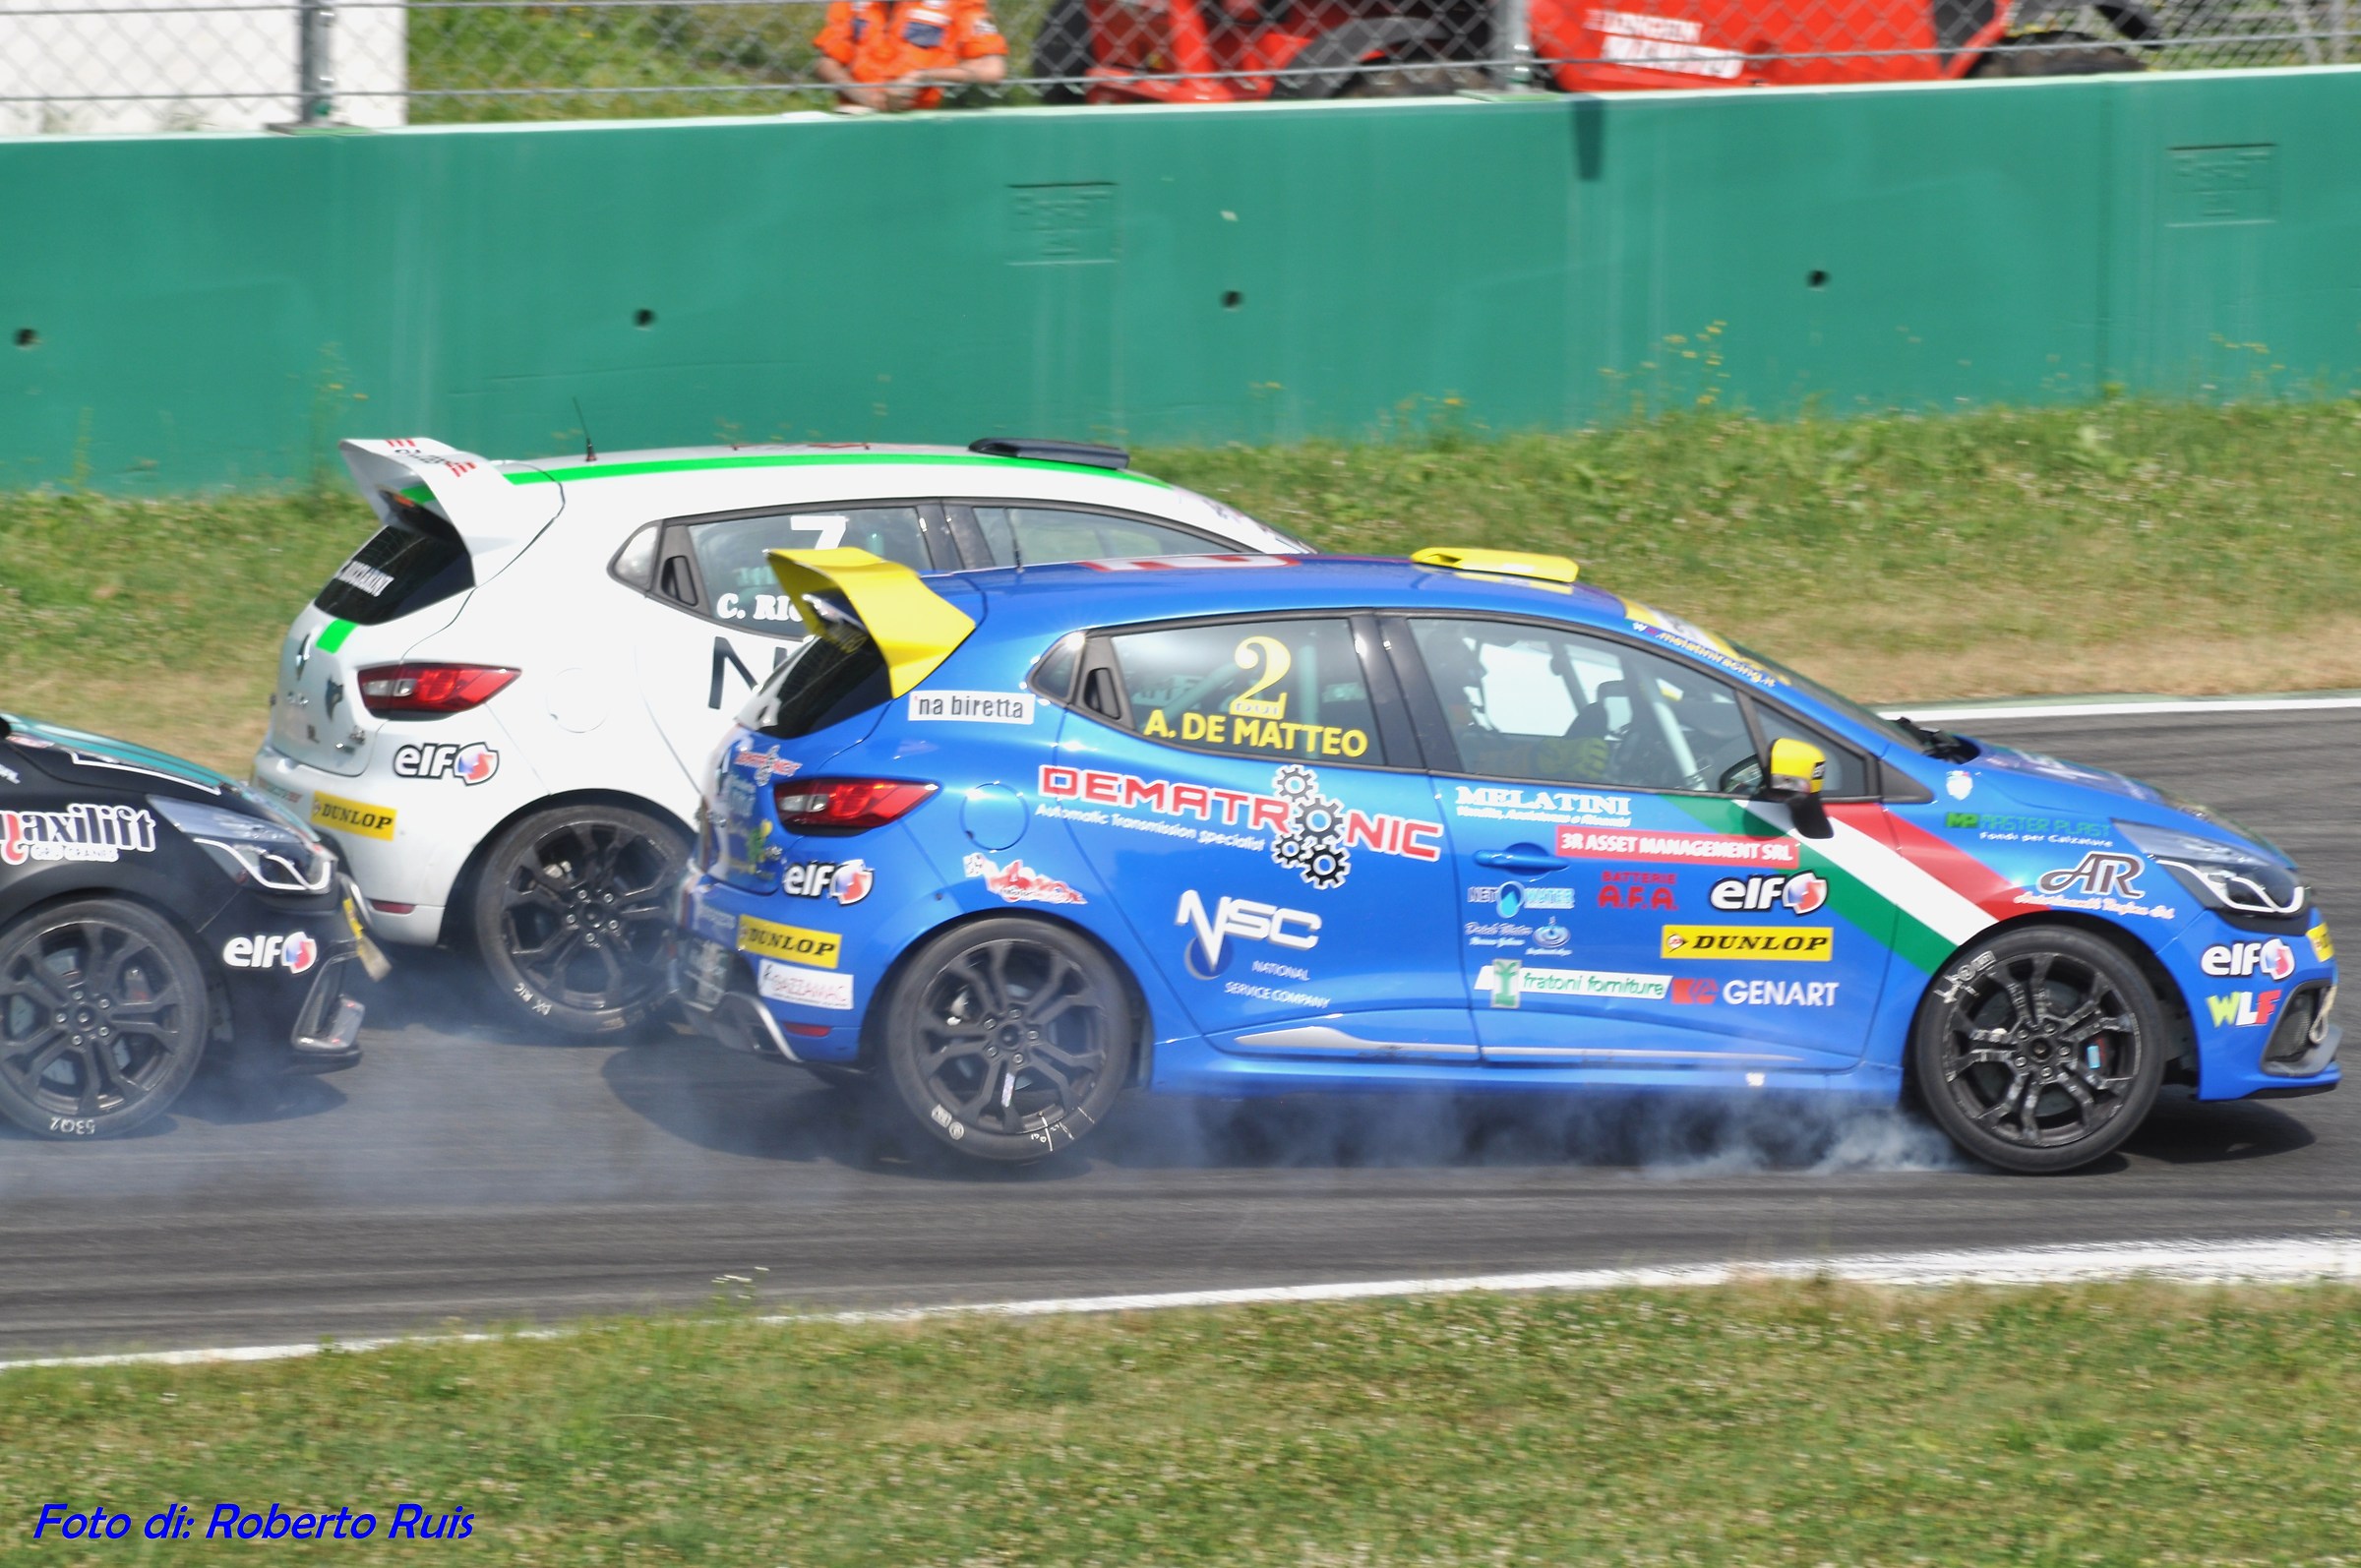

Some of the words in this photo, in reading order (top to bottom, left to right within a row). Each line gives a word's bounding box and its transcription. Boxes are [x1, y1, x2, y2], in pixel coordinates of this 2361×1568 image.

[716, 592, 746, 620] C.
[1230, 635, 1291, 720] 2
[951, 694, 1023, 719] biretta
[1144, 709, 1177, 738] A.
[1181, 712, 1227, 743] DE
[1233, 718, 1368, 757] MATTEO
[393, 743, 459, 779] elf
[1456, 786, 1632, 815] MELATINI
[321, 803, 394, 830] DUNLOP
[1035, 803, 1109, 825] Automatic
[1111, 813, 1197, 839] Transmission
[1560, 833, 1585, 851] 3R
[1585, 834, 1637, 854] ASSET
[1639, 838, 1761, 860] MANAGEMENT
[1761, 844, 1794, 862] SRL
[783, 863, 835, 898] elf
[1601, 871, 1677, 885] BATTERIE
[1597, 884, 1679, 911] A.F.A.
[1710, 874, 1786, 912] elf
[222, 935, 283, 969] elf
[748, 928, 835, 956] DUNLOP
[1692, 935, 1828, 951] DUNLOP
[1251, 960, 1310, 982] NATIONAL
[2201, 940, 2262, 977] elf
[1224, 981, 1272, 1000] SERVICE
[1271, 989, 1331, 1009] COMPANY
[1523, 972, 1584, 991] fratoni
[1587, 974, 1664, 995] forniture
[1723, 979, 1840, 1006] GENART
[2207, 990, 2282, 1029] WLF
